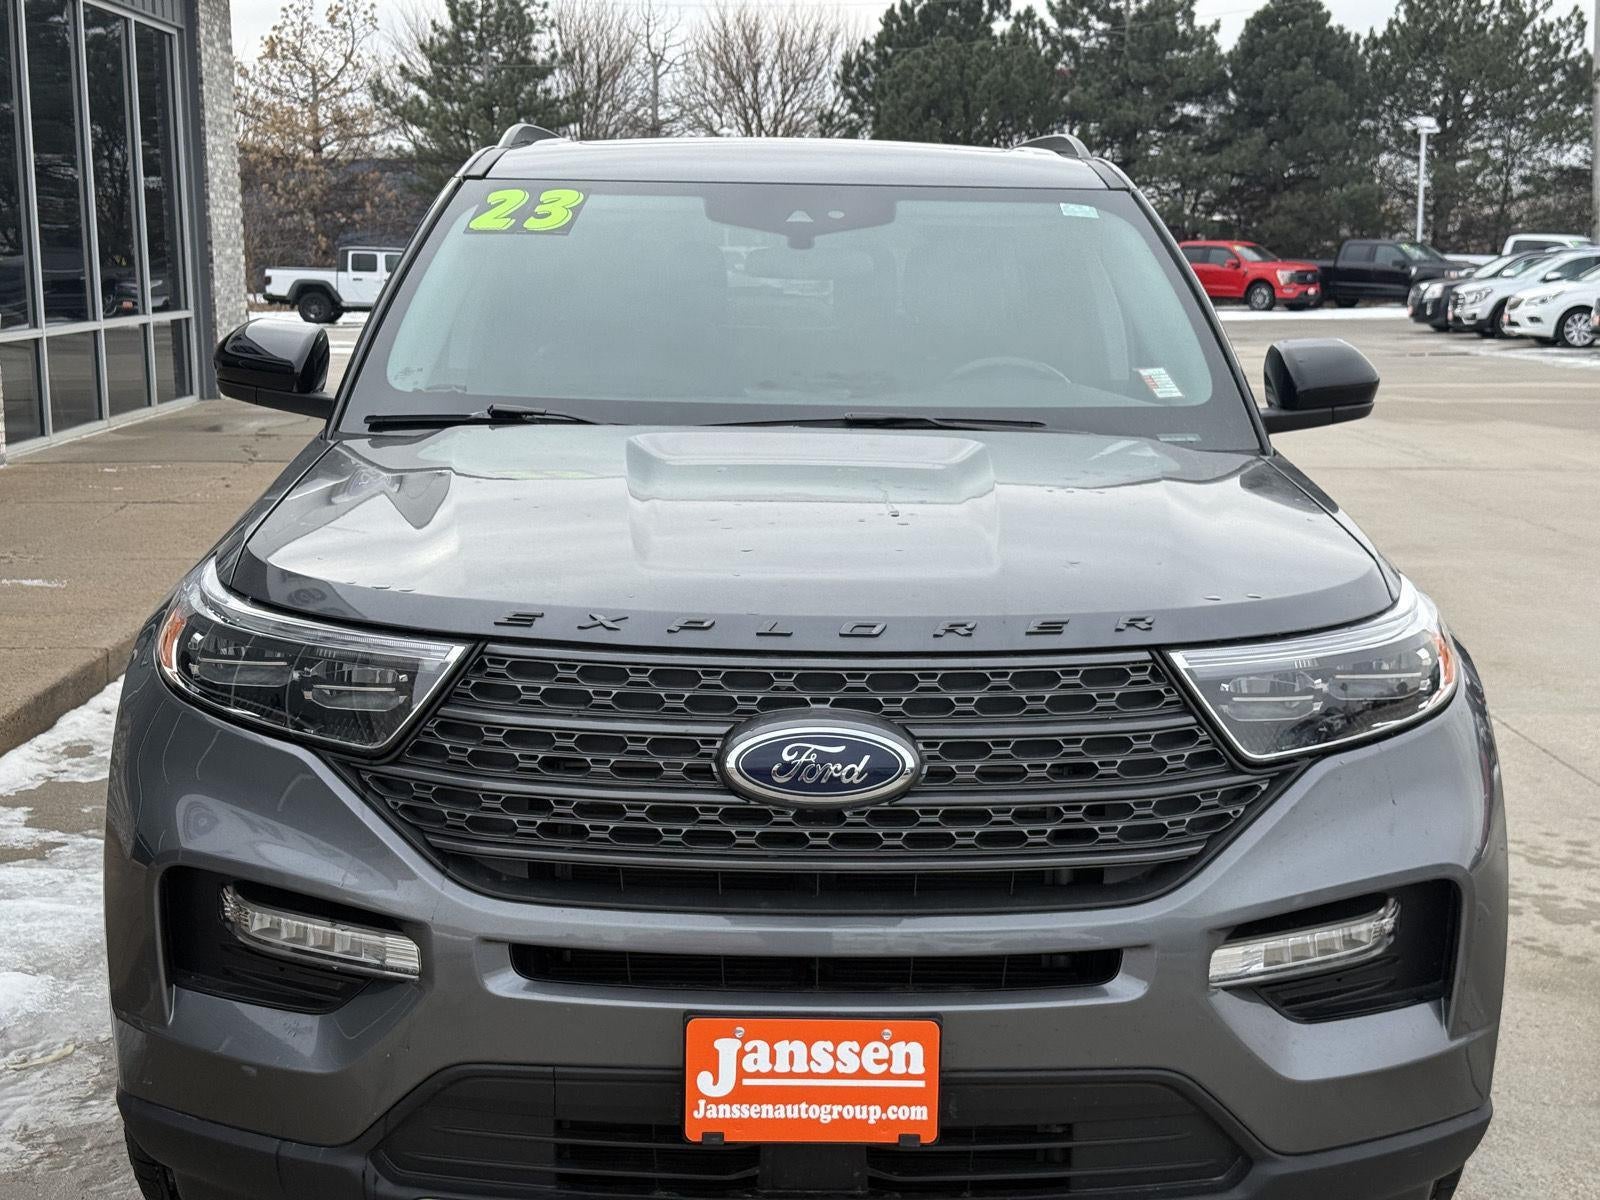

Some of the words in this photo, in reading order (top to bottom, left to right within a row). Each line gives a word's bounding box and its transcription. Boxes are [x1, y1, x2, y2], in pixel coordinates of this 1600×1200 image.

[469, 189, 584, 231] 23
[494, 611, 1155, 638] EXPLORER
[771, 742, 871, 784] Ford
[696, 1038, 926, 1097] Janssen
[693, 1099, 928, 1124] Janssenautogroup.com
